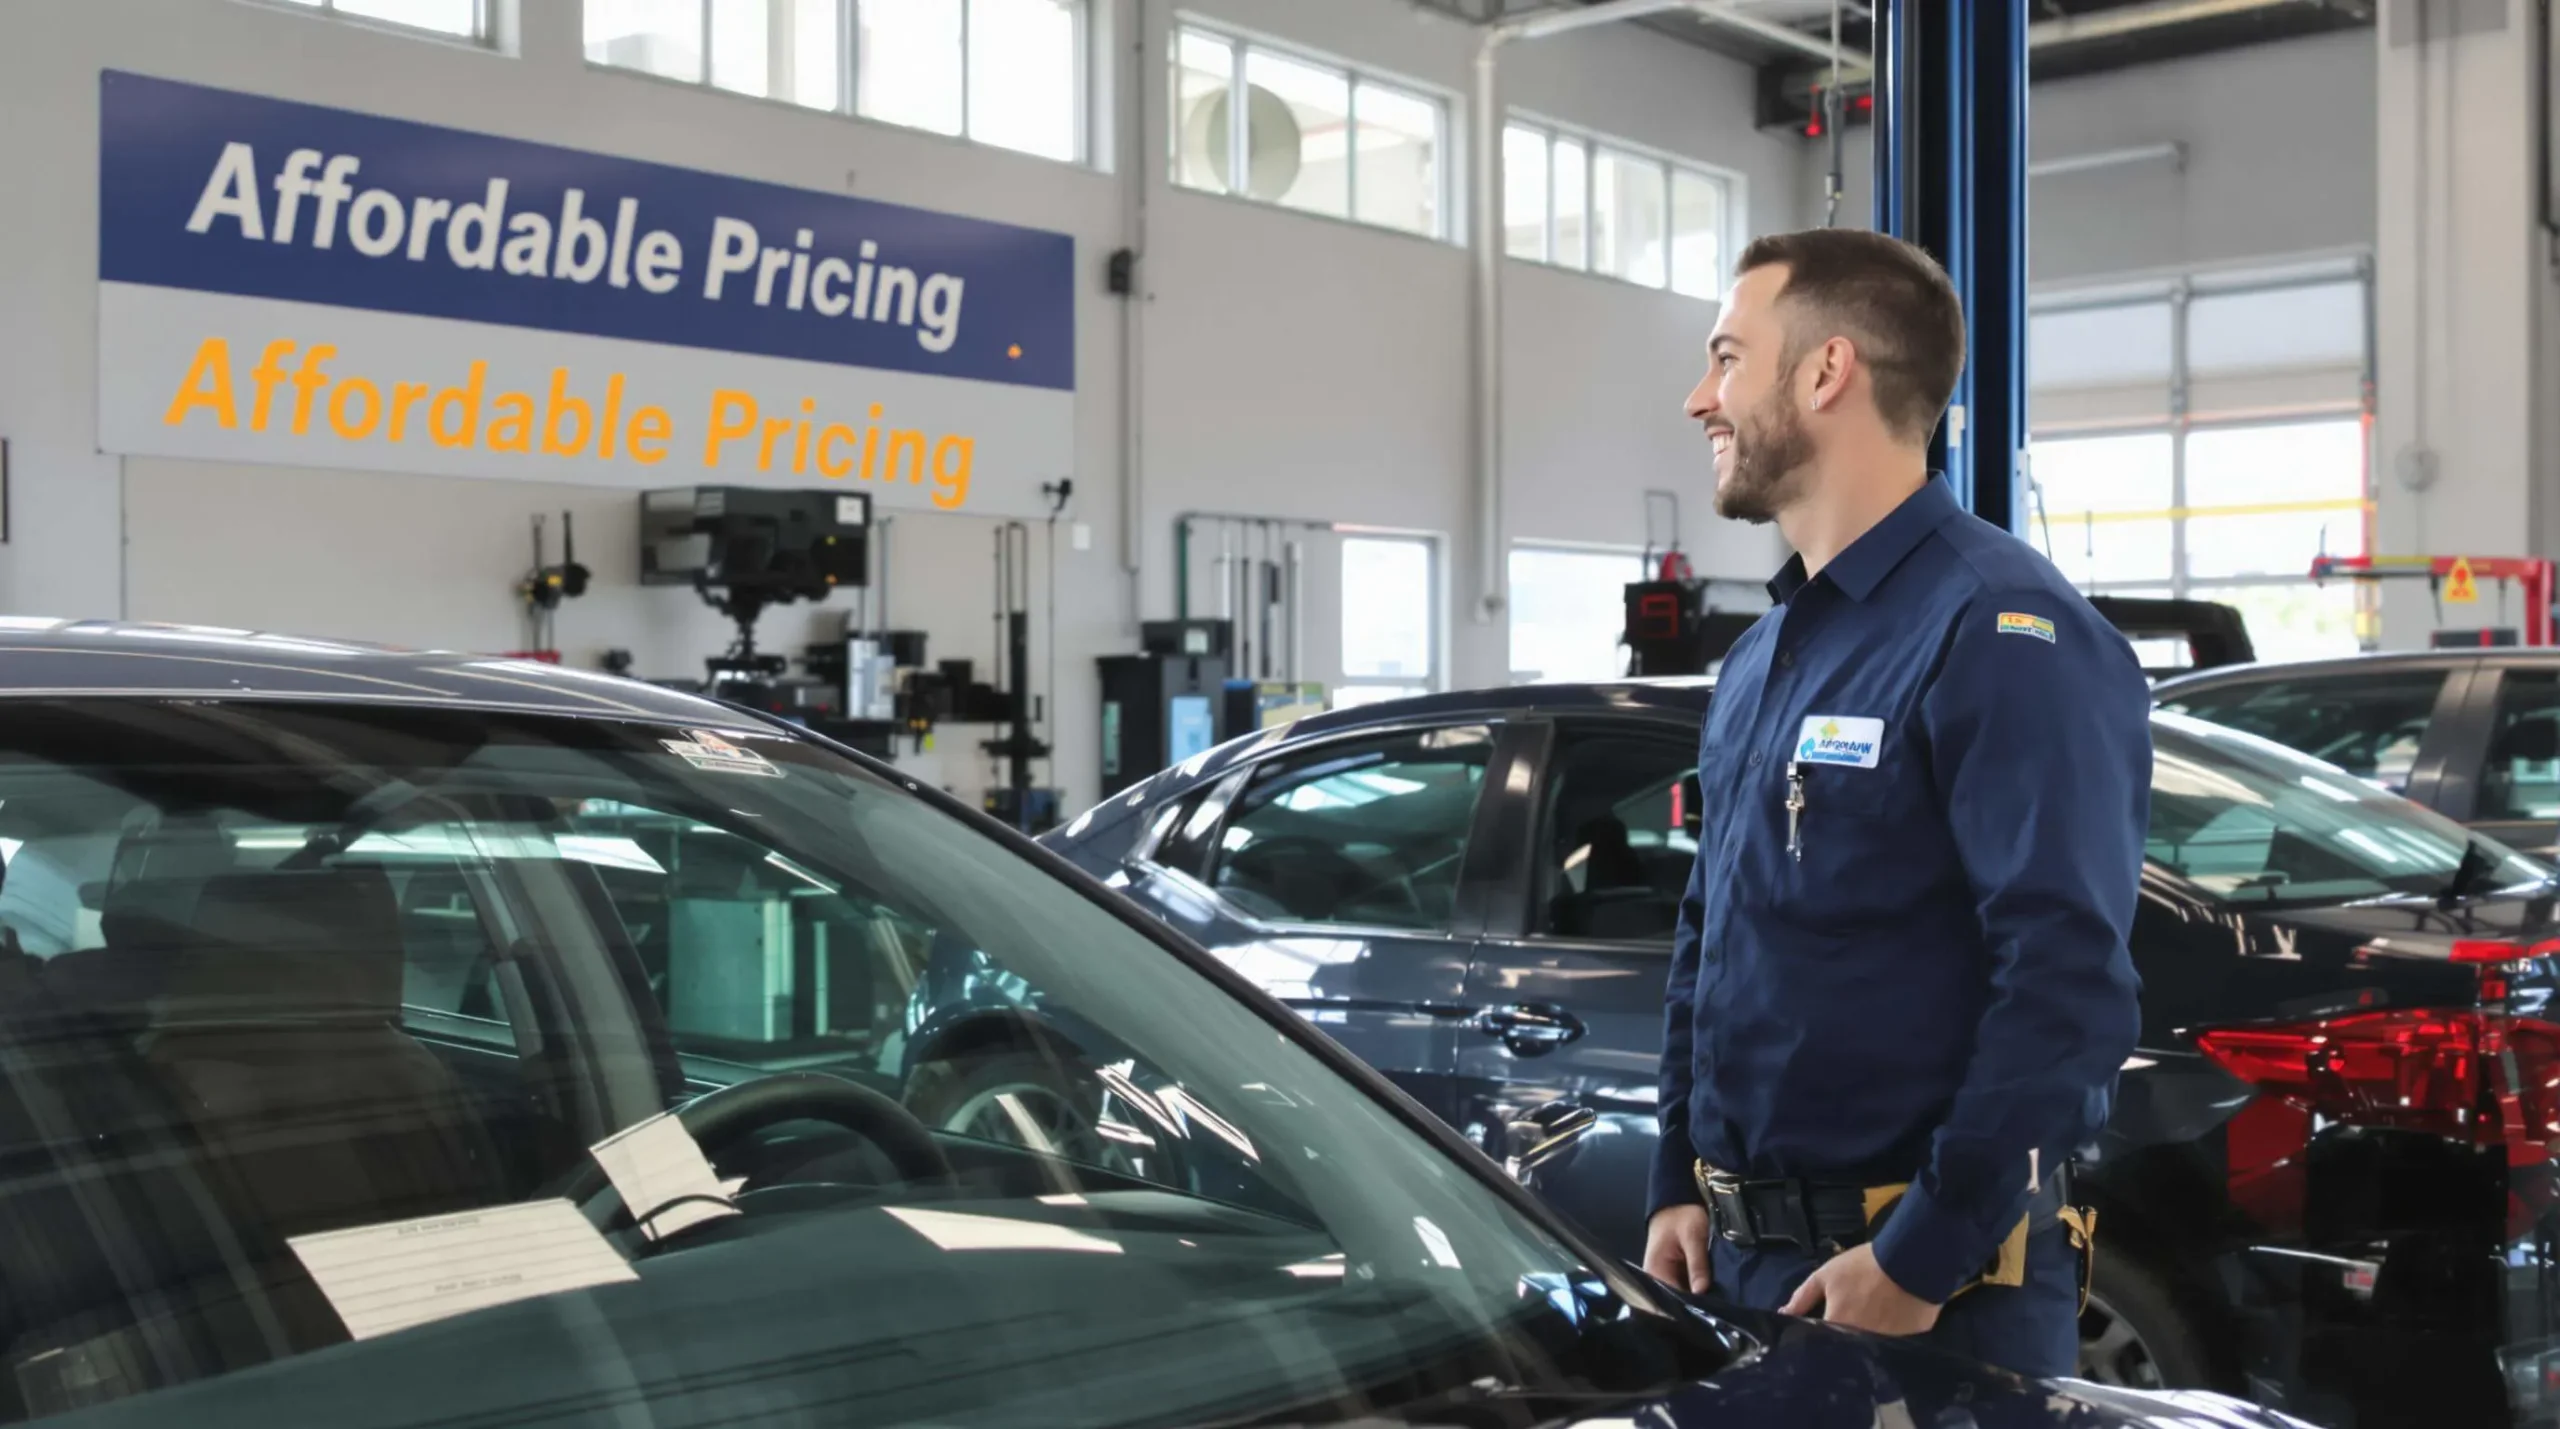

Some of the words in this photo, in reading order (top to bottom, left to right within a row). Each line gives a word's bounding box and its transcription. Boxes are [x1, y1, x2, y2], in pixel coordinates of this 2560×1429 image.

[184, 139, 683, 294] Affordable
[702, 215, 965, 354] Pricing
[163, 337, 673, 465] Affordable
[703, 388, 975, 510] Pricing
